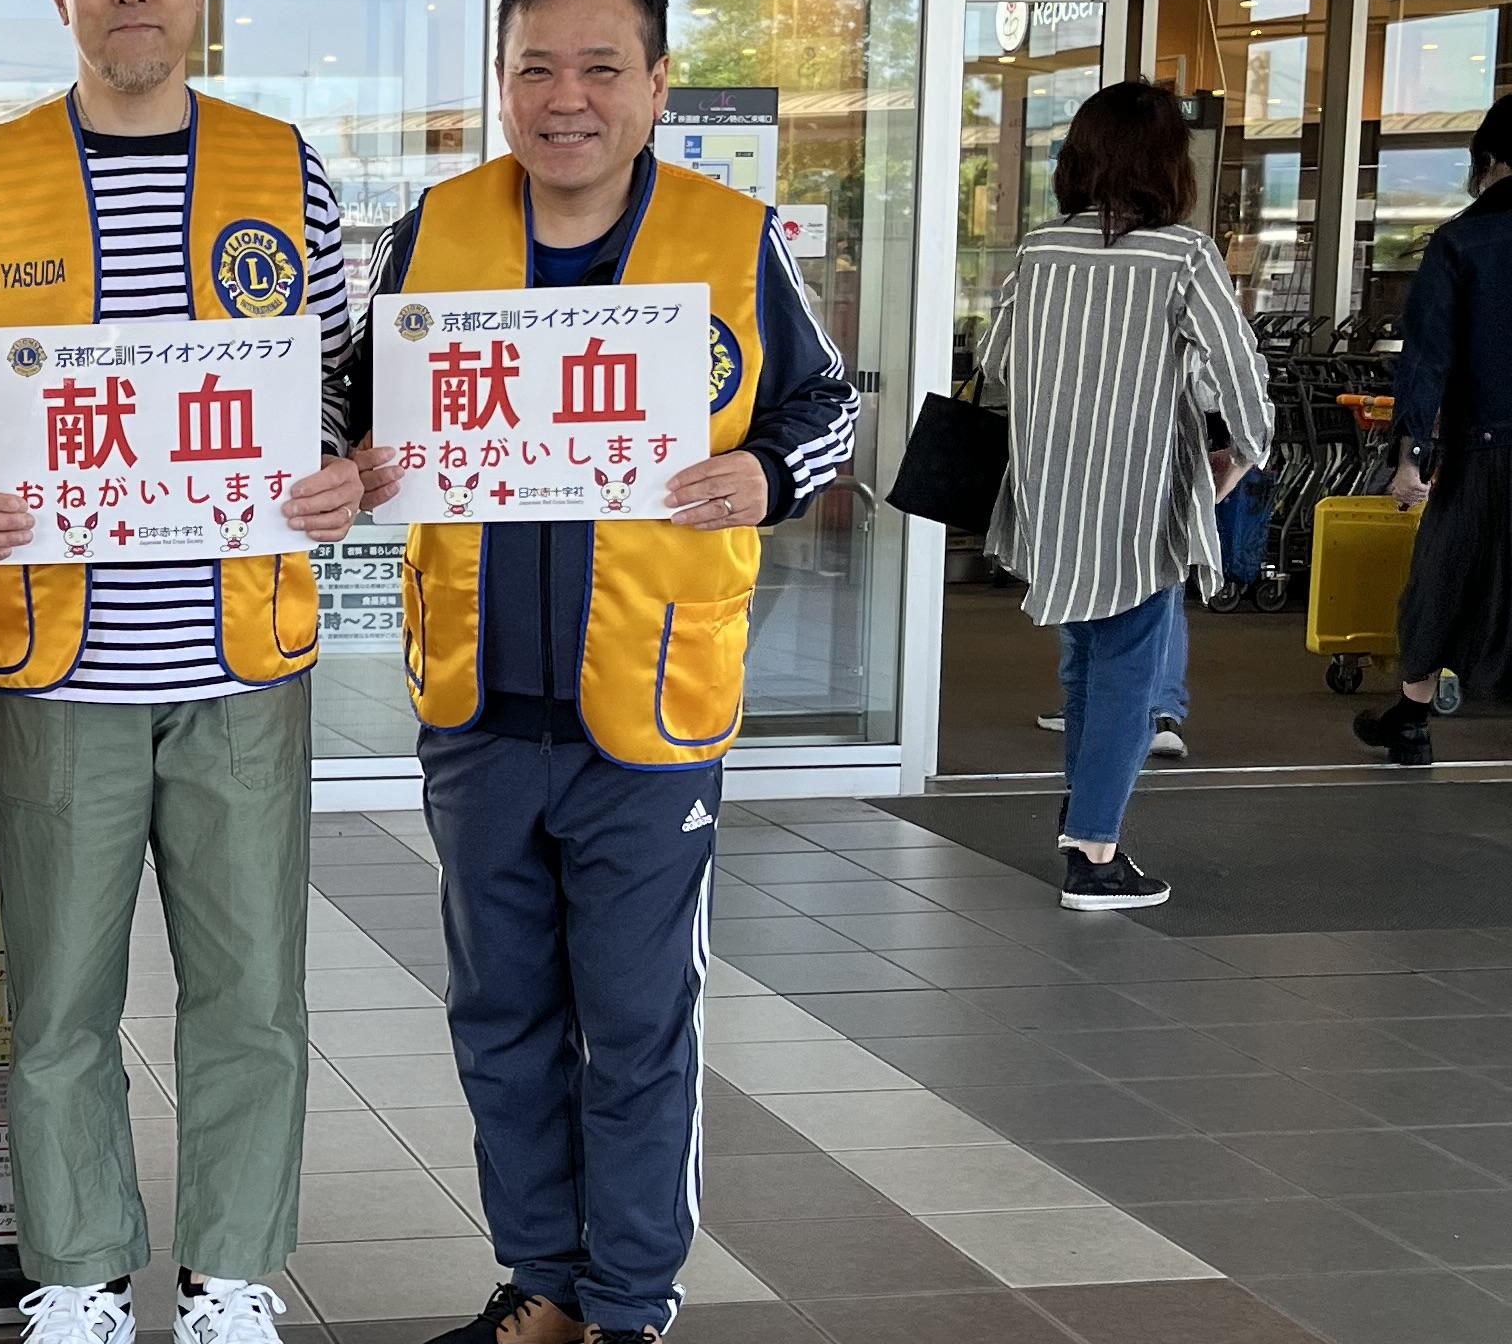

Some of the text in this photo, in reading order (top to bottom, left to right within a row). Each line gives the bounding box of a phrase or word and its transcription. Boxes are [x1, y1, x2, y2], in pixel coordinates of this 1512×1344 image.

[228, 232, 275, 253] LIONS
[245, 258, 269, 290] L
[441, 302, 683, 332] 京都乙訓ライオンズクラブ
[54, 337, 296, 368] 京都乙訓ライオンズクラブ
[428, 335, 646, 433] 献血
[42, 372, 263, 472] 献血
[398, 432, 679, 471] おねがいします
[15, 469, 293, 512] おねがいします
[518, 485, 585, 498] 日本赤十字社
[138, 525, 204, 539] 日本赤十字社
